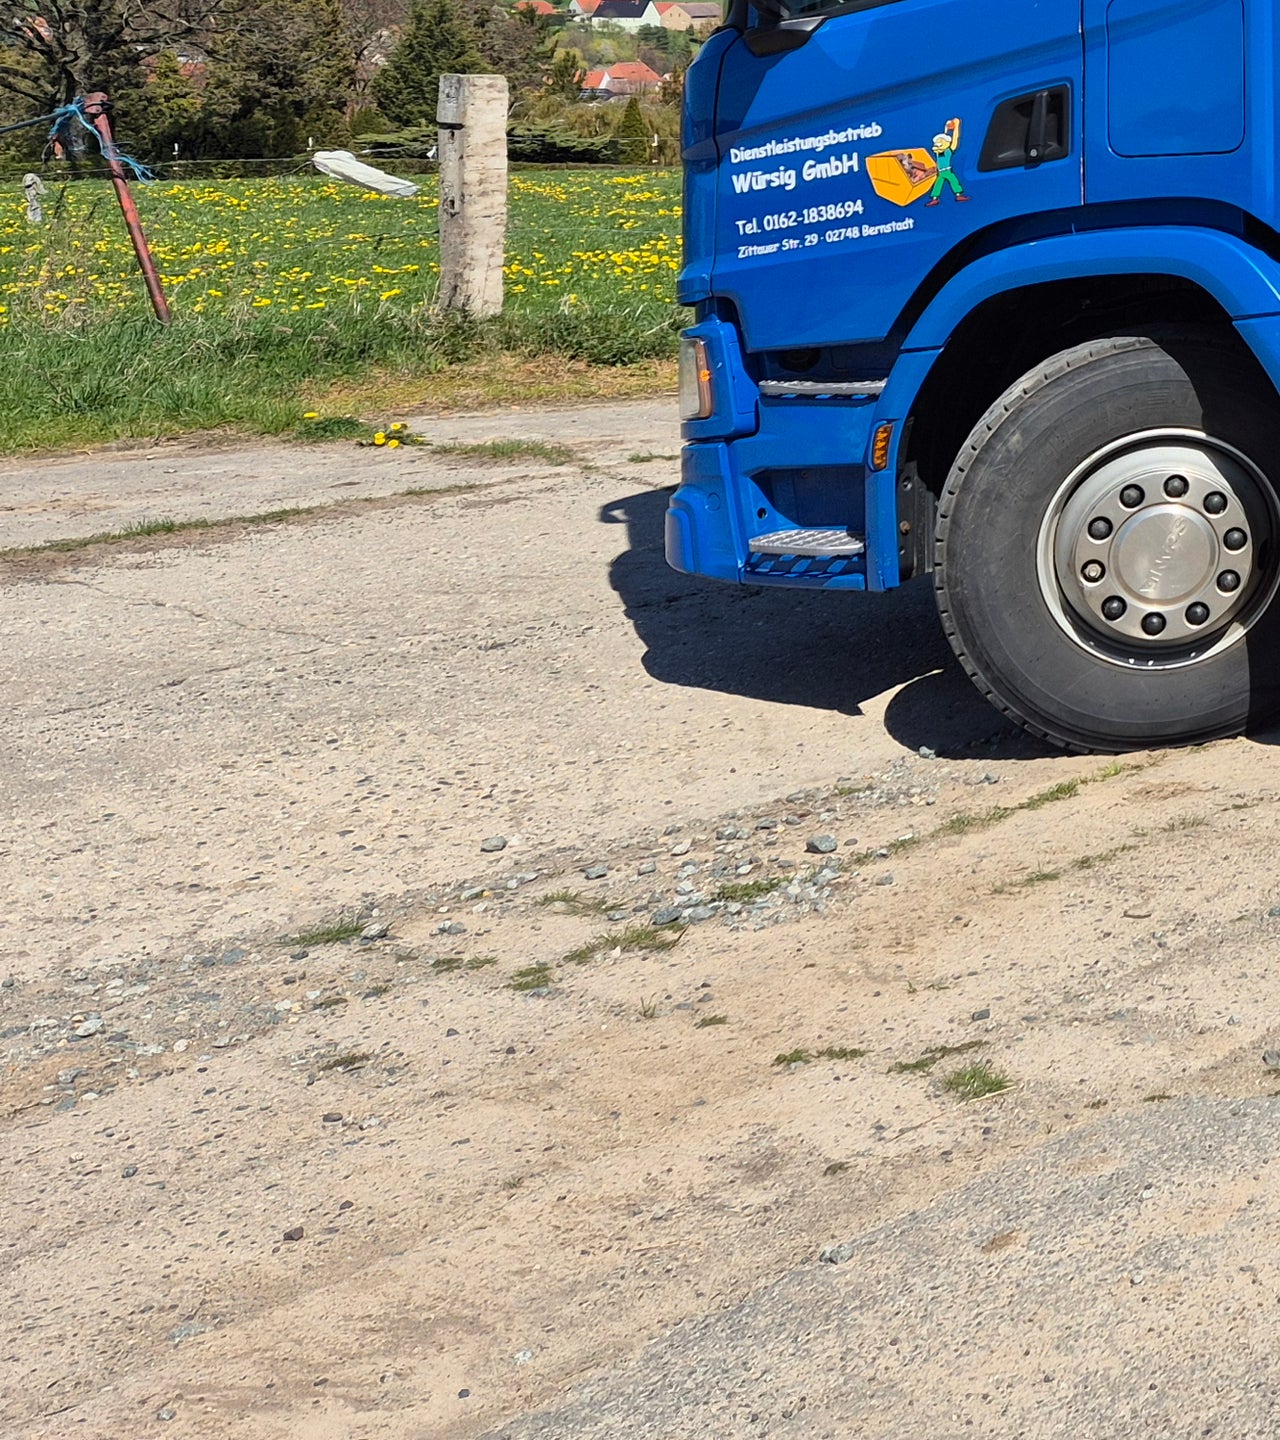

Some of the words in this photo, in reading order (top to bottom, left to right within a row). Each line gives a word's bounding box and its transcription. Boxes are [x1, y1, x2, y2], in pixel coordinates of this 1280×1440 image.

[730, 122, 882, 164] Dienstleistungsbetrieb
[732, 167, 796, 193] Würsig
[802, 153, 858, 181] GmbH
[735, 219, 761, 236] Tel.
[763, 199, 864, 230] 0162-1838694
[737, 240, 779, 258] Zittauer
[782, 236, 802, 251] Str.
[804, 233, 818, 246] 29
[825, 227, 860, 244] 02748
[862, 217, 914, 237] Bernstadt
